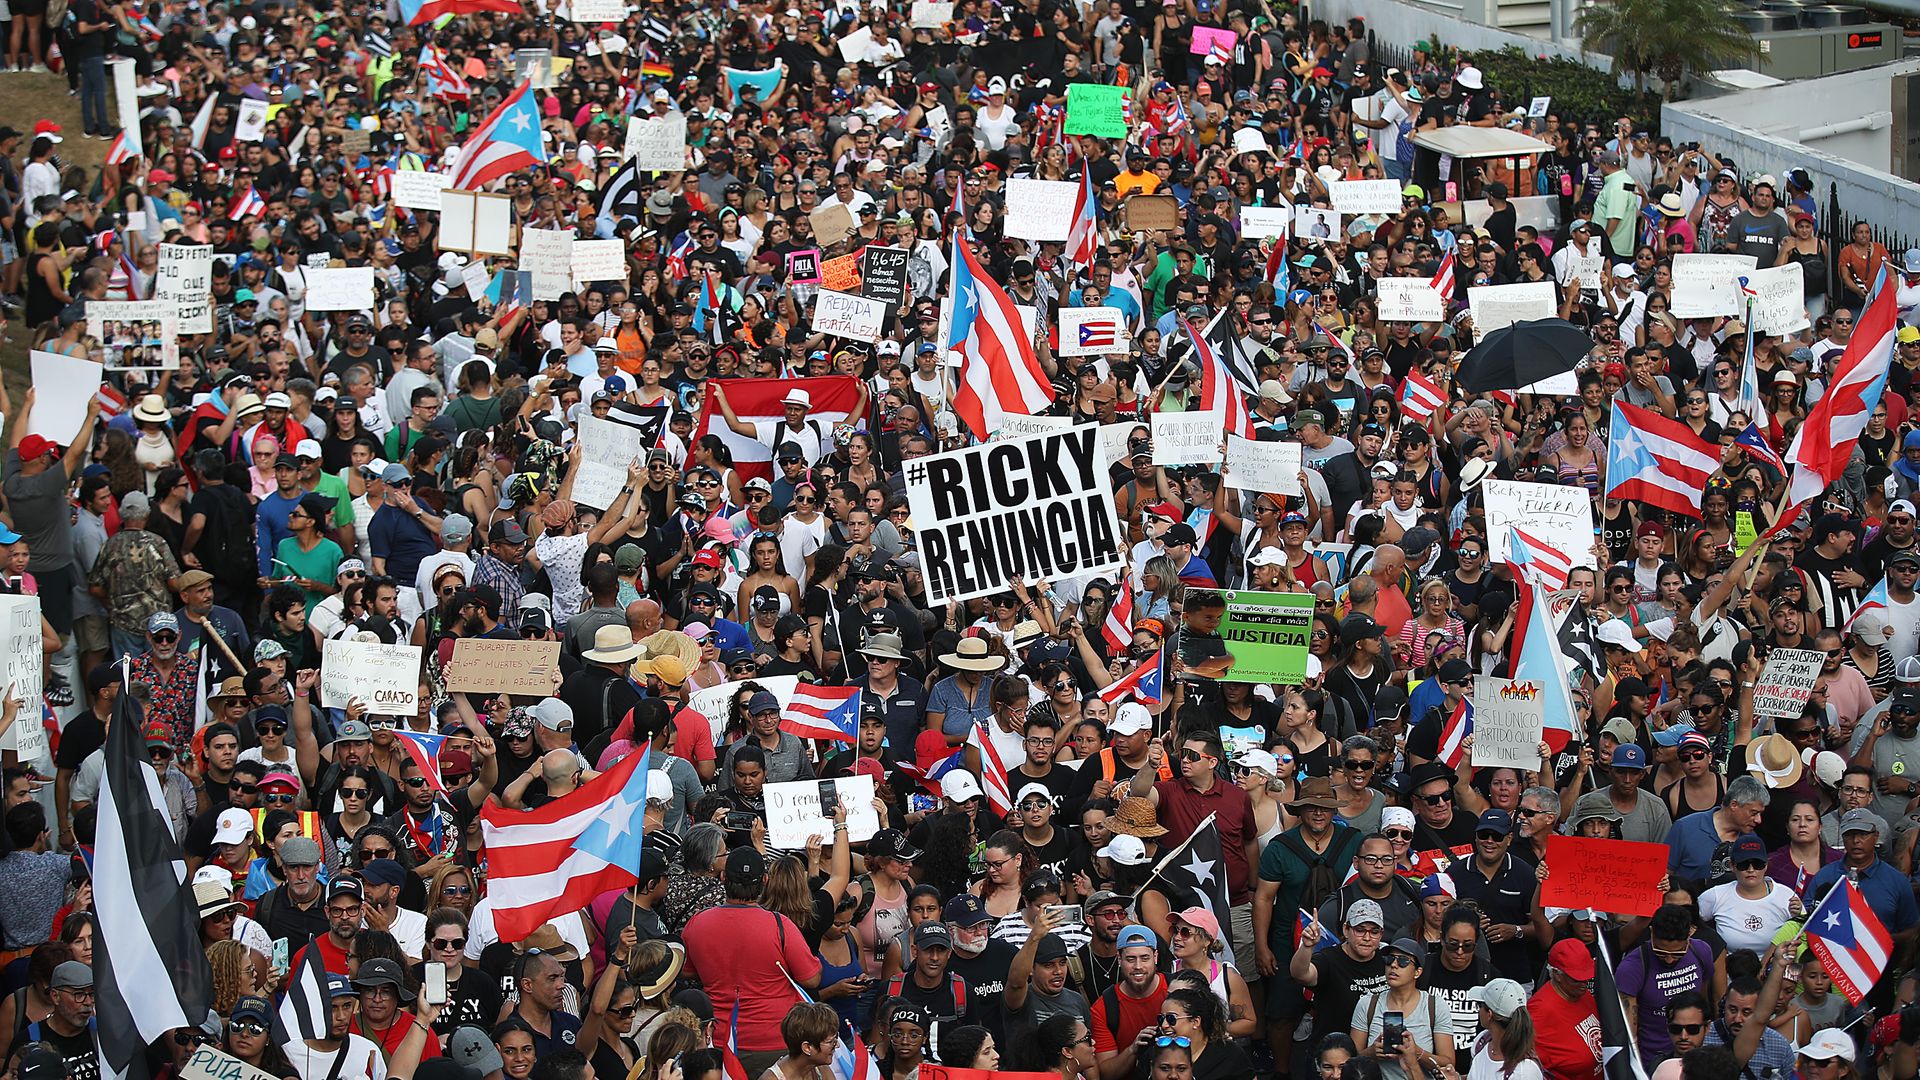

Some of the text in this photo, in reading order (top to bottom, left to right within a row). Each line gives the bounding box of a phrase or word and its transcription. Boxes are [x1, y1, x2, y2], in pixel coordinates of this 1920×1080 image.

[871, 251, 905, 266] 4,645
[872, 267, 894, 276] almas
[183, 277, 205, 289] QUE
[1379, 281, 1399, 291] Este
[1400, 293, 1413, 302] NO
[178, 305, 209, 319] RICKY
[824, 295, 871, 317] REDADA
[1381, 308, 1394, 316] me
[1757, 306, 1789, 320] 4,645
[841, 312, 853, 321] EN
[818, 318, 880, 338] FORTALEZA
[1183, 423, 1193, 434] NOS
[907, 427, 1097, 521] #RICKY
[1485, 482, 1521, 501] Ricky
[1535, 486, 1547, 499] El
[1545, 516, 1572, 530] tus
[920, 494, 1120, 600] RENUNCIA
[1231, 613, 1242, 621] Ni
[1244, 605, 1264, 613] años
[1267, 606, 1279, 614] de
[1283, 608, 1312, 617] espera
[16, 610, 32, 628] TUS
[1223, 629, 1307, 646] JUSTICIA
[459, 641, 471, 650] TE
[475, 642, 517, 652] BURLASTE
[522, 644, 531, 652] DE
[326, 643, 354, 667] Ricky
[365, 657, 384, 666] eres
[485, 660, 523, 669] MUERTES
[1230, 669, 1268, 677] Departamento
[17, 679, 31, 696] LAS
[355, 676, 367, 685] que
[388, 679, 398, 688] ex
[473, 677, 481, 685] LA
[486, 678, 495, 686] DE
[513, 678, 546, 686] ABUELA
[375, 690, 413, 704] CARAJO
[1478, 681, 1498, 704] LA
[1504, 690, 1530, 701] FURIA
[1476, 707, 1491, 725] ES
[1493, 710, 1504, 726] EL
[1475, 725, 1536, 744] PARTIDO QUE
[1474, 744, 1520, 760] NOS UNE
[1568, 872, 1587, 884] RIP
[1568, 883, 1599, 903] Ricky
[1656, 964, 1697, 979] ANTIPATRIARCAL
[1657, 972, 1698, 989] FEMINISTA
[974, 981, 1004, 997] sejodió
[1429, 986, 1449, 999] UNA
[1664, 983, 1696, 996] LESBIANA
[893, 1010, 919, 1022] 2021
[192, 1050, 242, 1080] PUTA
